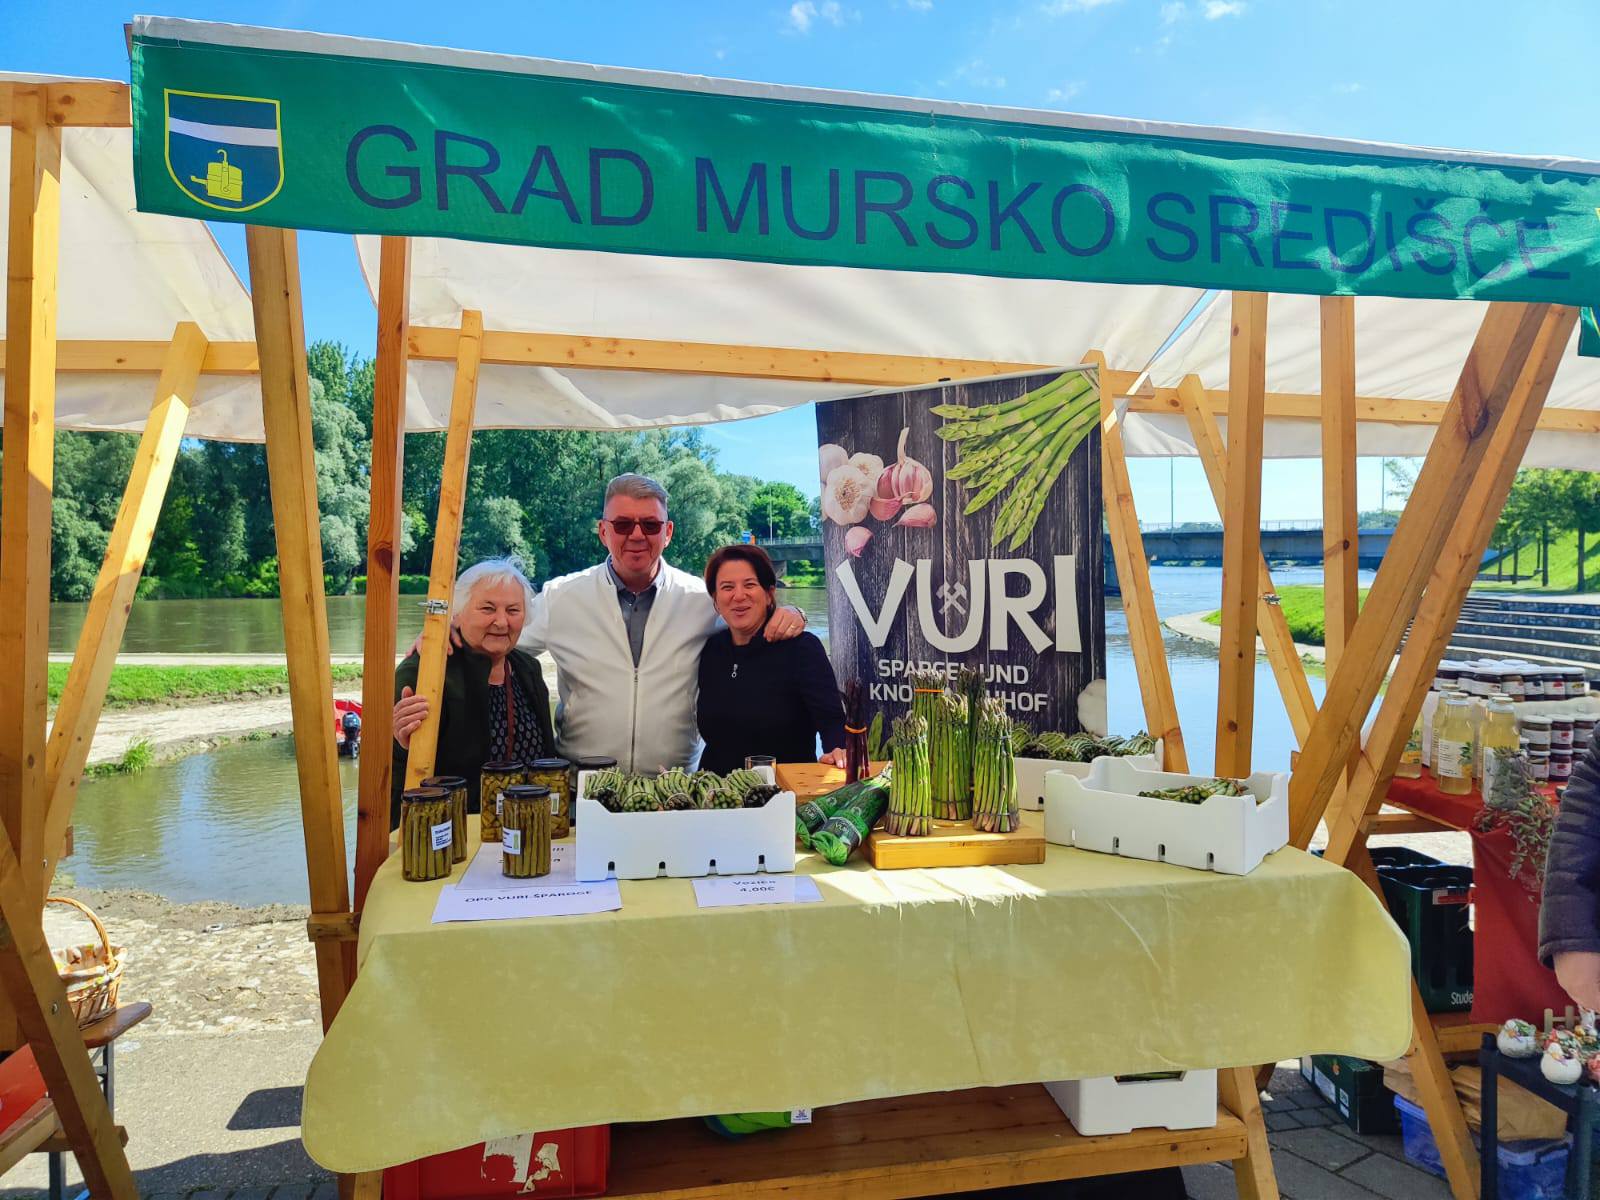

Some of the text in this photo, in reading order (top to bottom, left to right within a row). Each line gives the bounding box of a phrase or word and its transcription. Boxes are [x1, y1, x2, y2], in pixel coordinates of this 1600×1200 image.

[345, 124, 655, 227] GRAD
[694, 156, 1117, 257] MURSKO
[835, 554, 1083, 655] VURI
[979, 663, 1029, 685] UND
